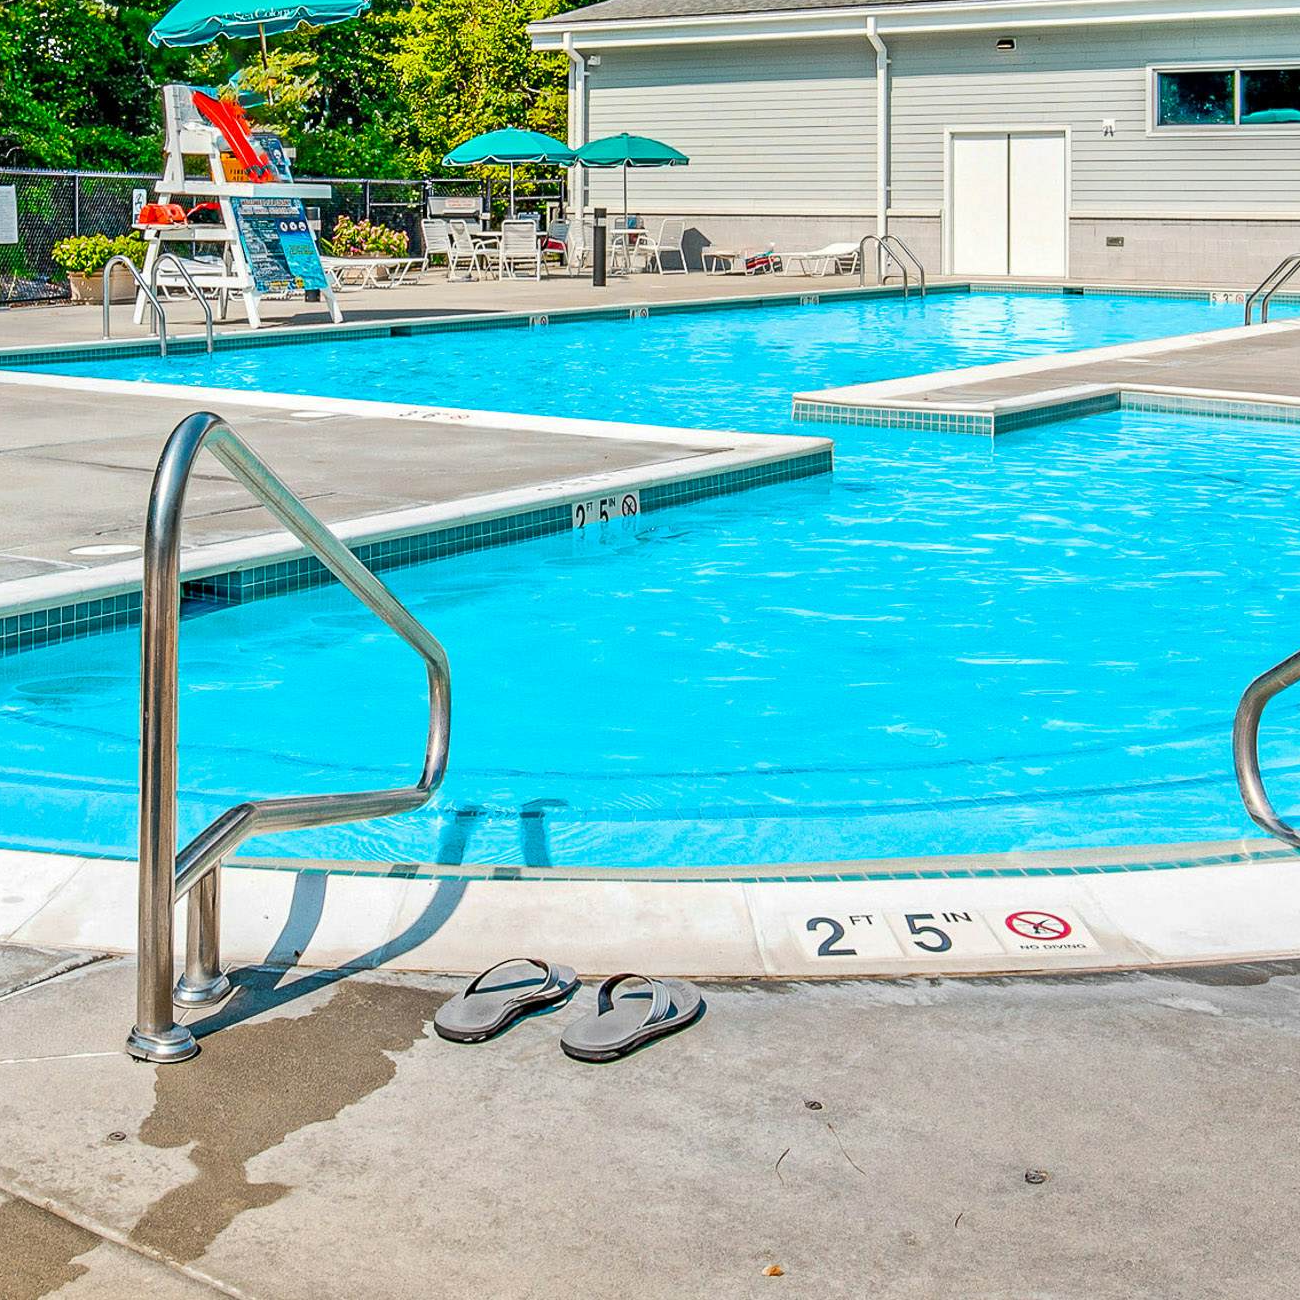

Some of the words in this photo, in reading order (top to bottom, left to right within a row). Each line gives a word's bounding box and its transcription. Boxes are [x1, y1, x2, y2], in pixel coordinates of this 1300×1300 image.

[234, 11, 254, 21] Sea
[586, 501, 593, 512] FT
[599, 498, 609, 523] 5
[608, 497, 616, 508] IN
[806, 916, 858, 957] 2
[849, 914, 874, 926] FT
[904, 912, 953, 953] 5
[942, 911, 973, 923] IN
